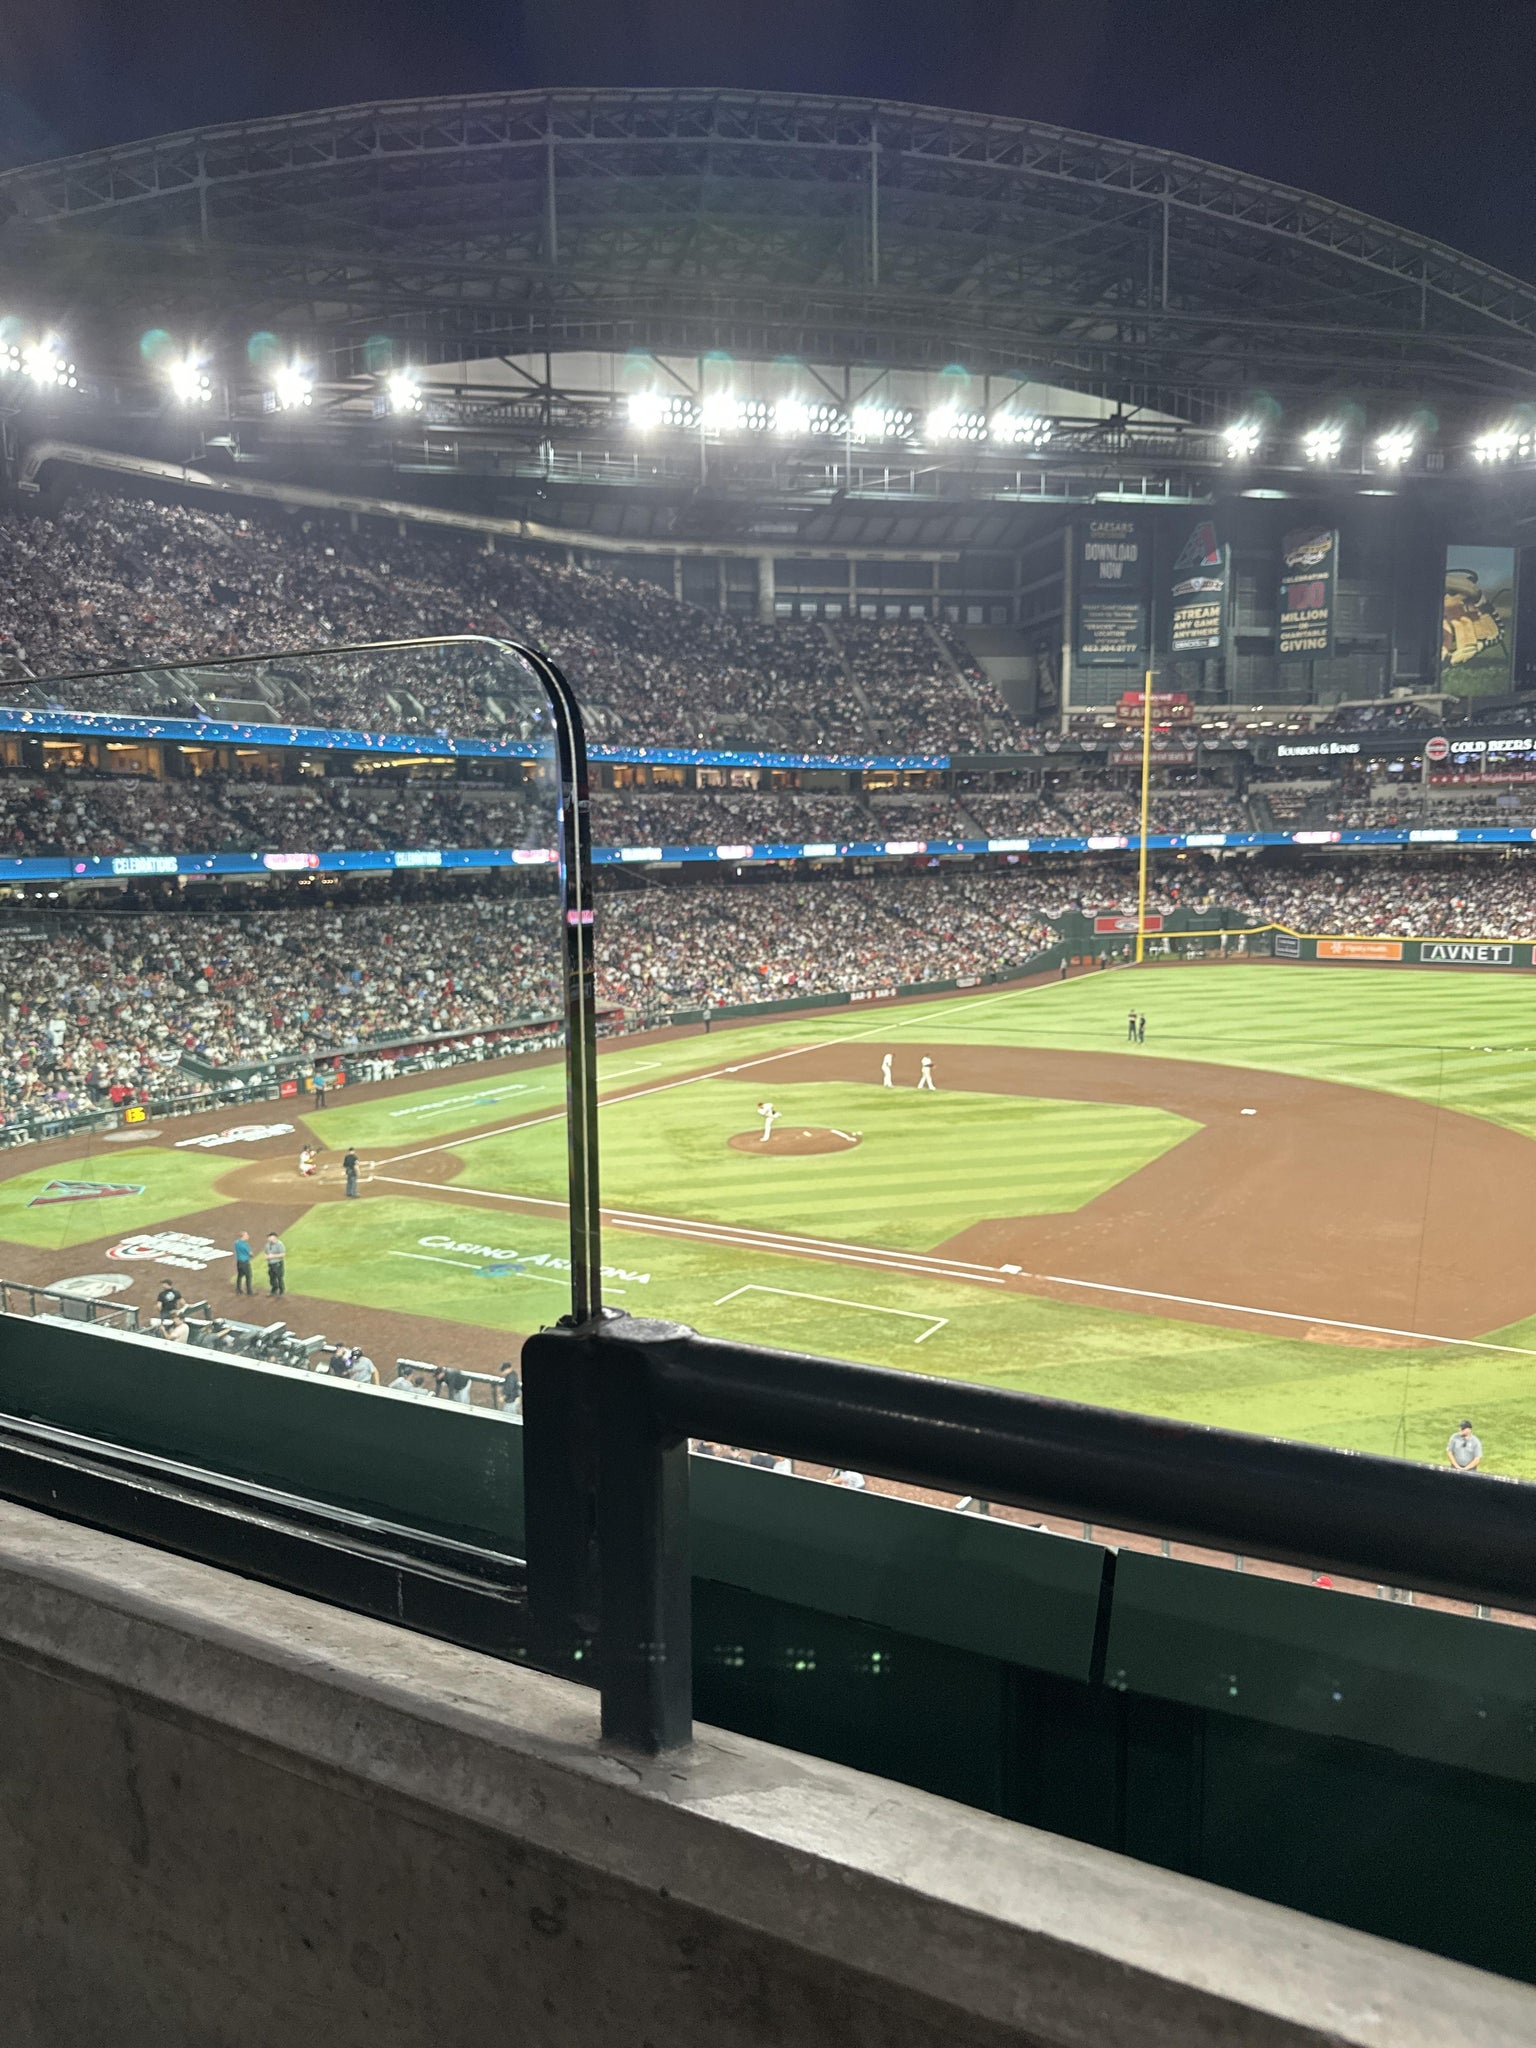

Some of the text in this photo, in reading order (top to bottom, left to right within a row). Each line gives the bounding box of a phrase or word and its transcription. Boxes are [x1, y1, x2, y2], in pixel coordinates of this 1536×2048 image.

[1085, 543, 1138, 561] DOWNLOAD
[1099, 562, 1123, 579] NOW
[1173, 606, 1220, 621] STREAM
[1281, 608, 1328, 623] MILLION
[1173, 617, 1219, 630] ANY GAME
[1173, 627, 1219, 639] ANYWHERE
[1280, 637, 1327, 652] GIVING
[1320, 743, 1329, 754] &
[1450, 741, 1487, 753] COLD
[1488, 739, 1532, 752] BEERS
[1430, 945, 1502, 960] AVNET
